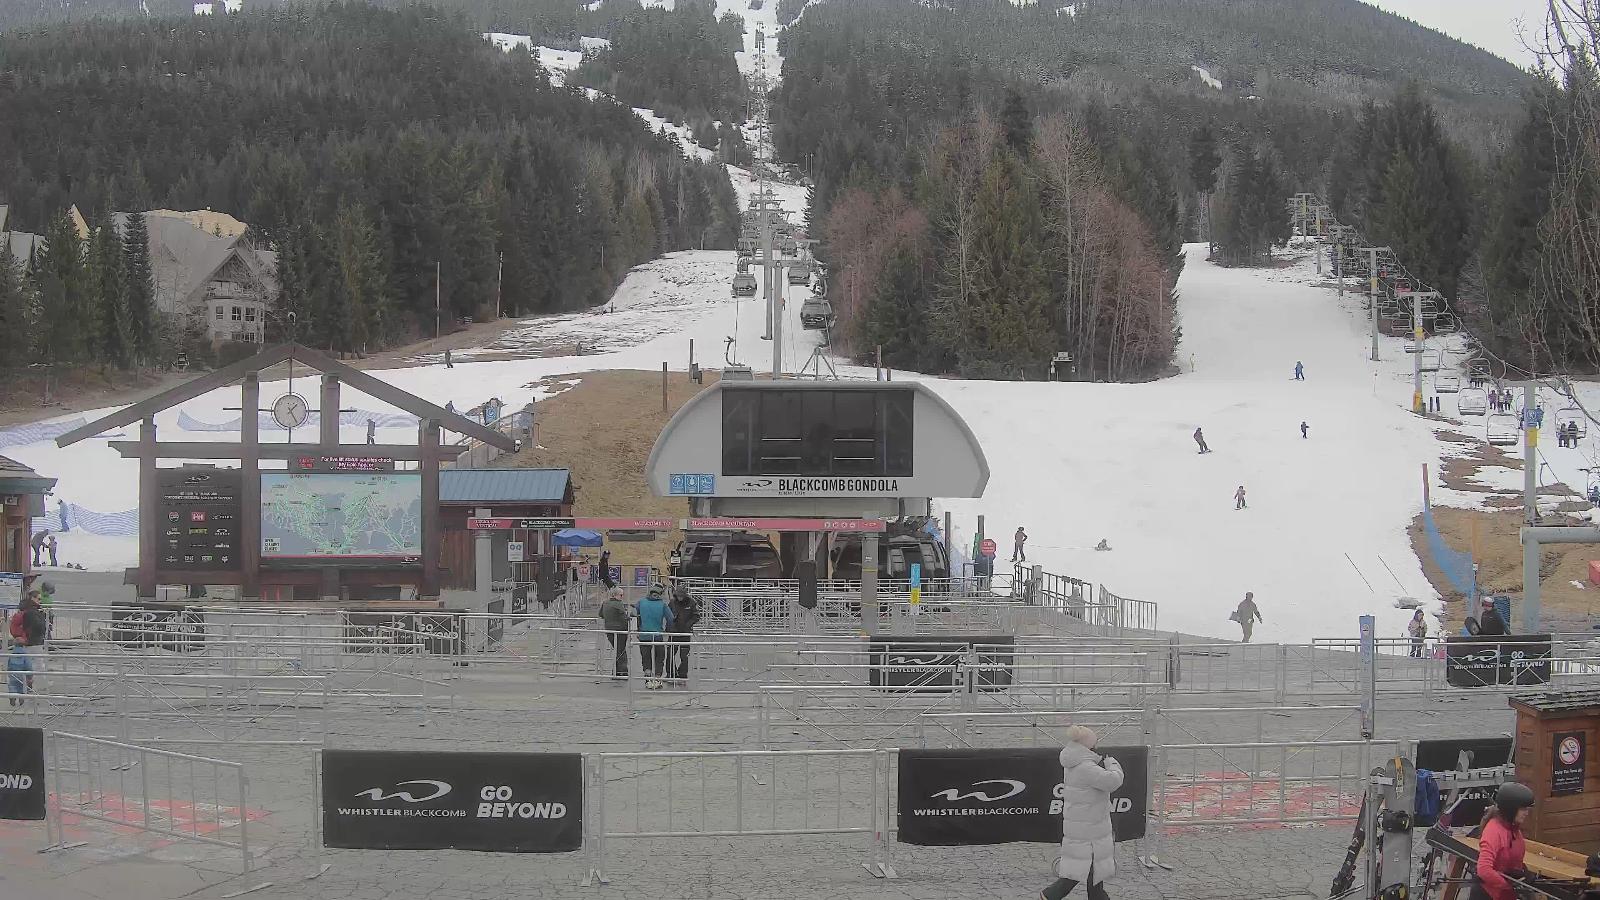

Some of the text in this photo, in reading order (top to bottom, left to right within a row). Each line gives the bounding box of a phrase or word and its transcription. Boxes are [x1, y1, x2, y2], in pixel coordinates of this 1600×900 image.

[778, 479, 898, 491] BLACKCOMB GONDOLA
[480, 785, 513, 801] GO
[476, 802, 567, 819] BEYOND
